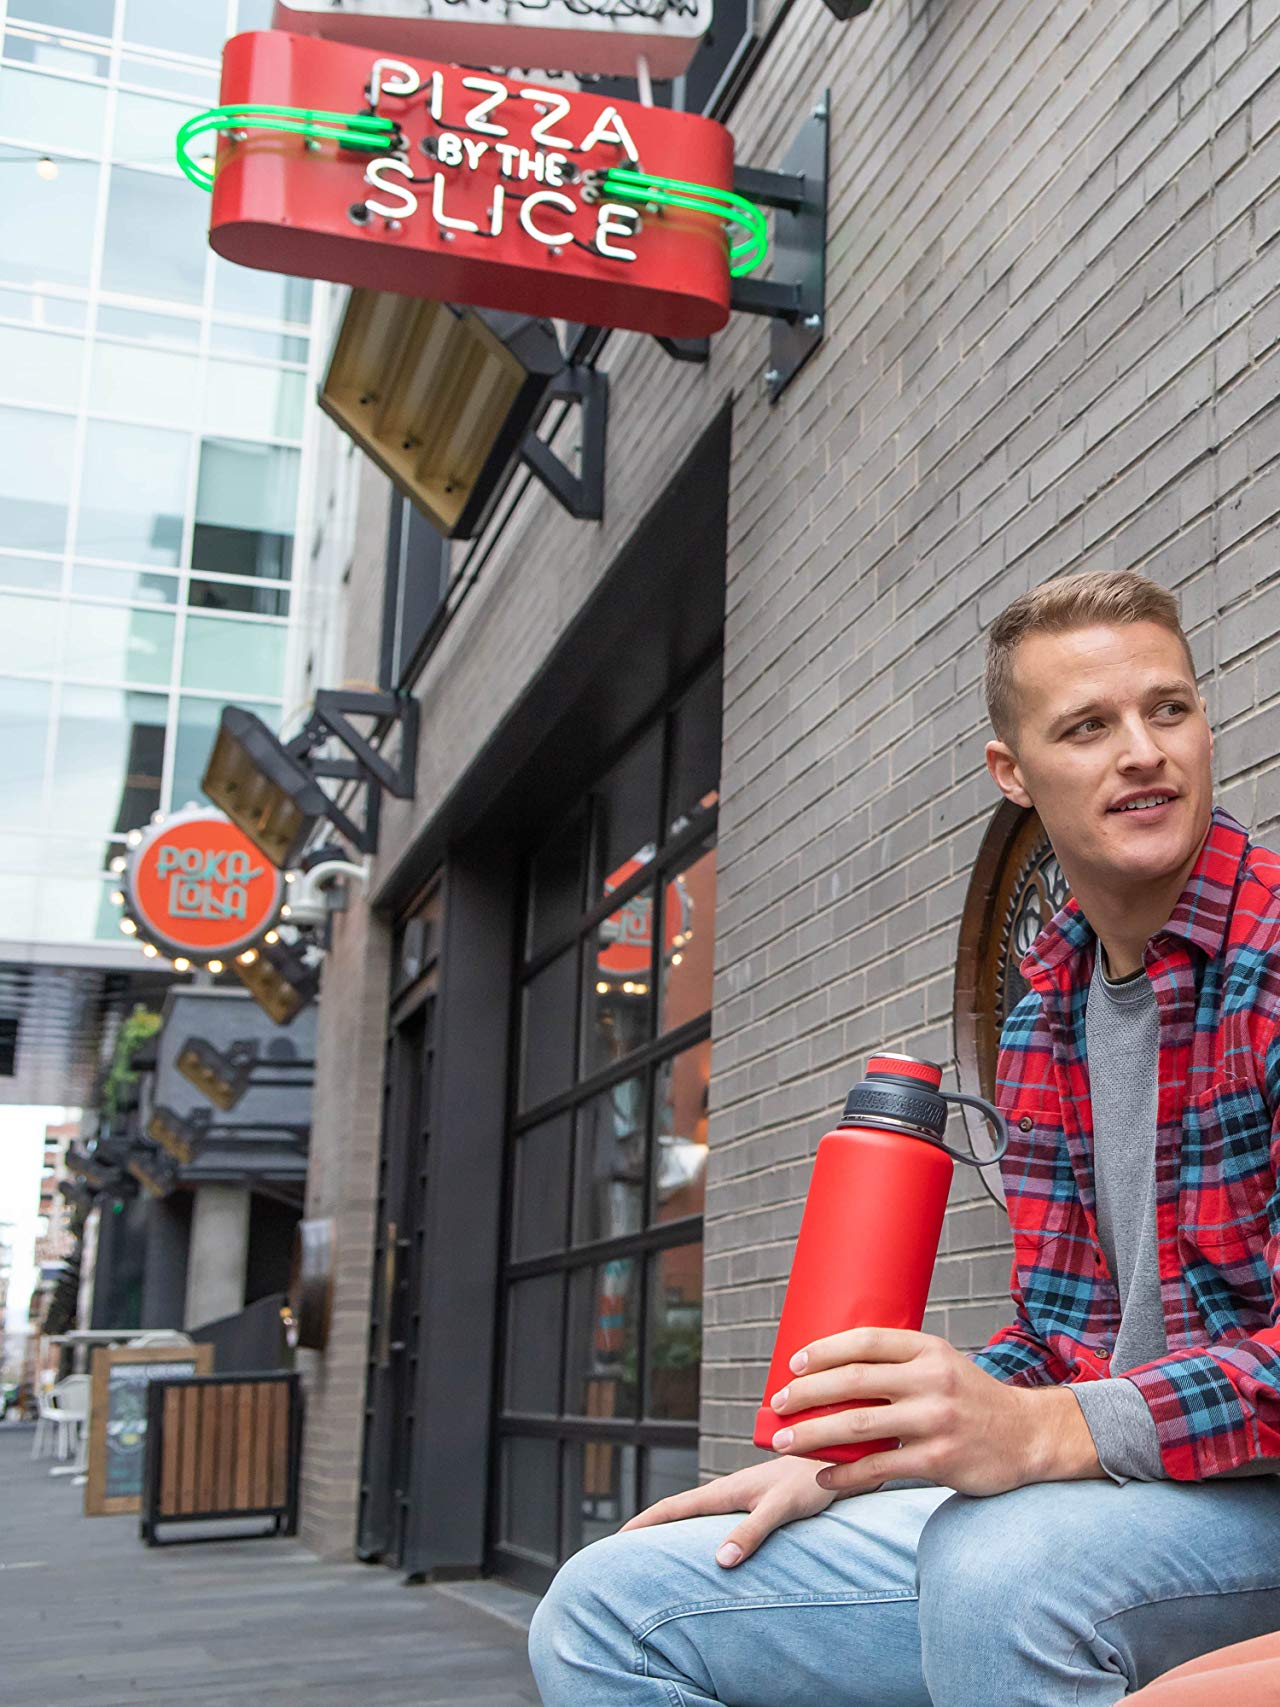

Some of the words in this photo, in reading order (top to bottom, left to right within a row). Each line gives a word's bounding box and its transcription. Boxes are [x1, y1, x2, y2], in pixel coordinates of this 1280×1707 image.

[371, 58, 639, 162] PIZZA
[437, 132, 489, 170] BY
[495, 143, 567, 187] THE
[365, 157, 639, 260] SLICE
[156, 846, 264, 884] POKA
[169, 873, 246, 919] LOLA
